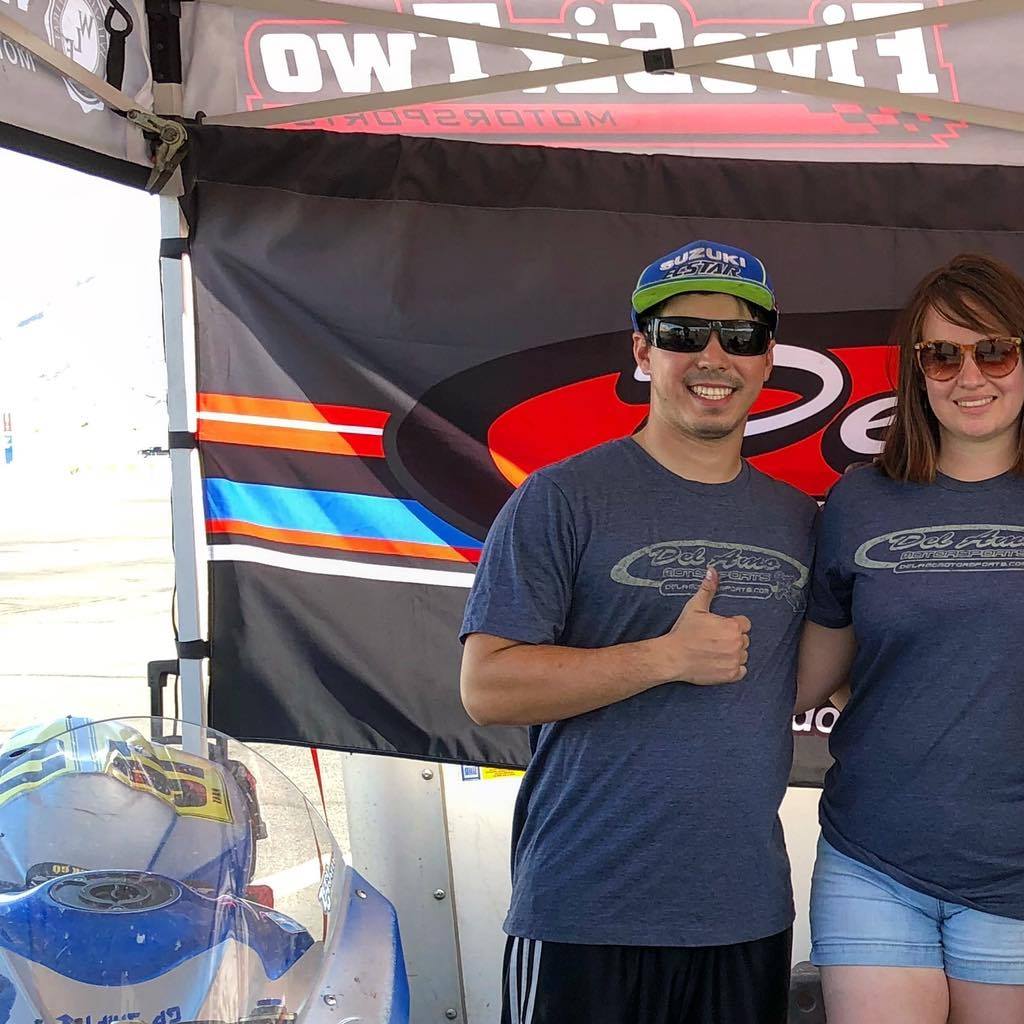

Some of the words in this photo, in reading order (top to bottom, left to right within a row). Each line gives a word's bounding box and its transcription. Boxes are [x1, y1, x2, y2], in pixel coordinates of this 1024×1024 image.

[659, 248, 747, 271] SUZUKI
[664, 260, 742, 279] ECSTAR
[889, 531, 954, 550] Del
[649, 547, 706, 566] Del
